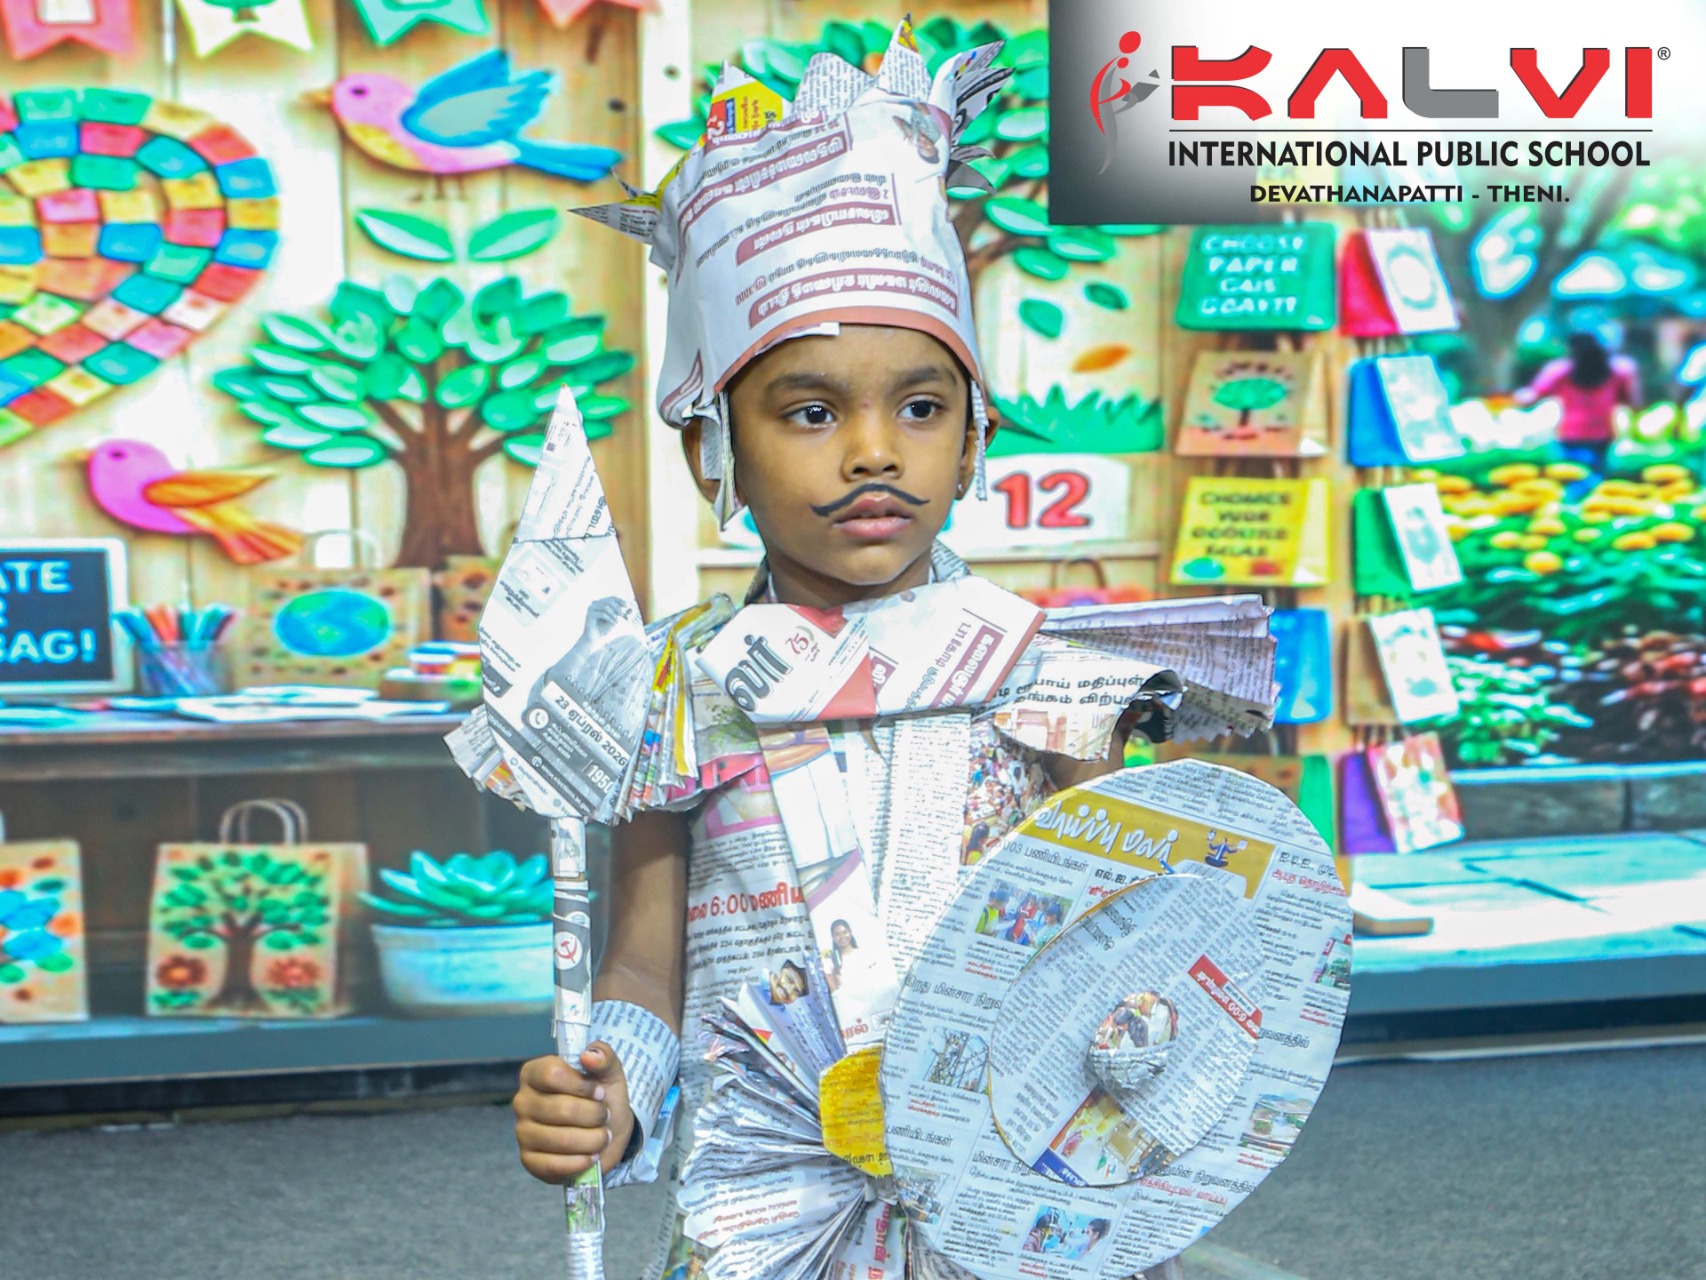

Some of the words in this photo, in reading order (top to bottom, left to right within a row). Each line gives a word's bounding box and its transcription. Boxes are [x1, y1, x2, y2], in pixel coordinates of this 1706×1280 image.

[993, 471, 1092, 529] 12
[0, 628, 97, 664] AG!
[784, 635, 810, 658] 75
[554, 694, 570, 710] 23
[565, 706, 605, 745] ஏப்ரல்
[600, 739, 628, 766] 2026
[1023, 843, 1089, 873] பணியிடங்கள்
[932, 980, 974, 1004] மின்சார
